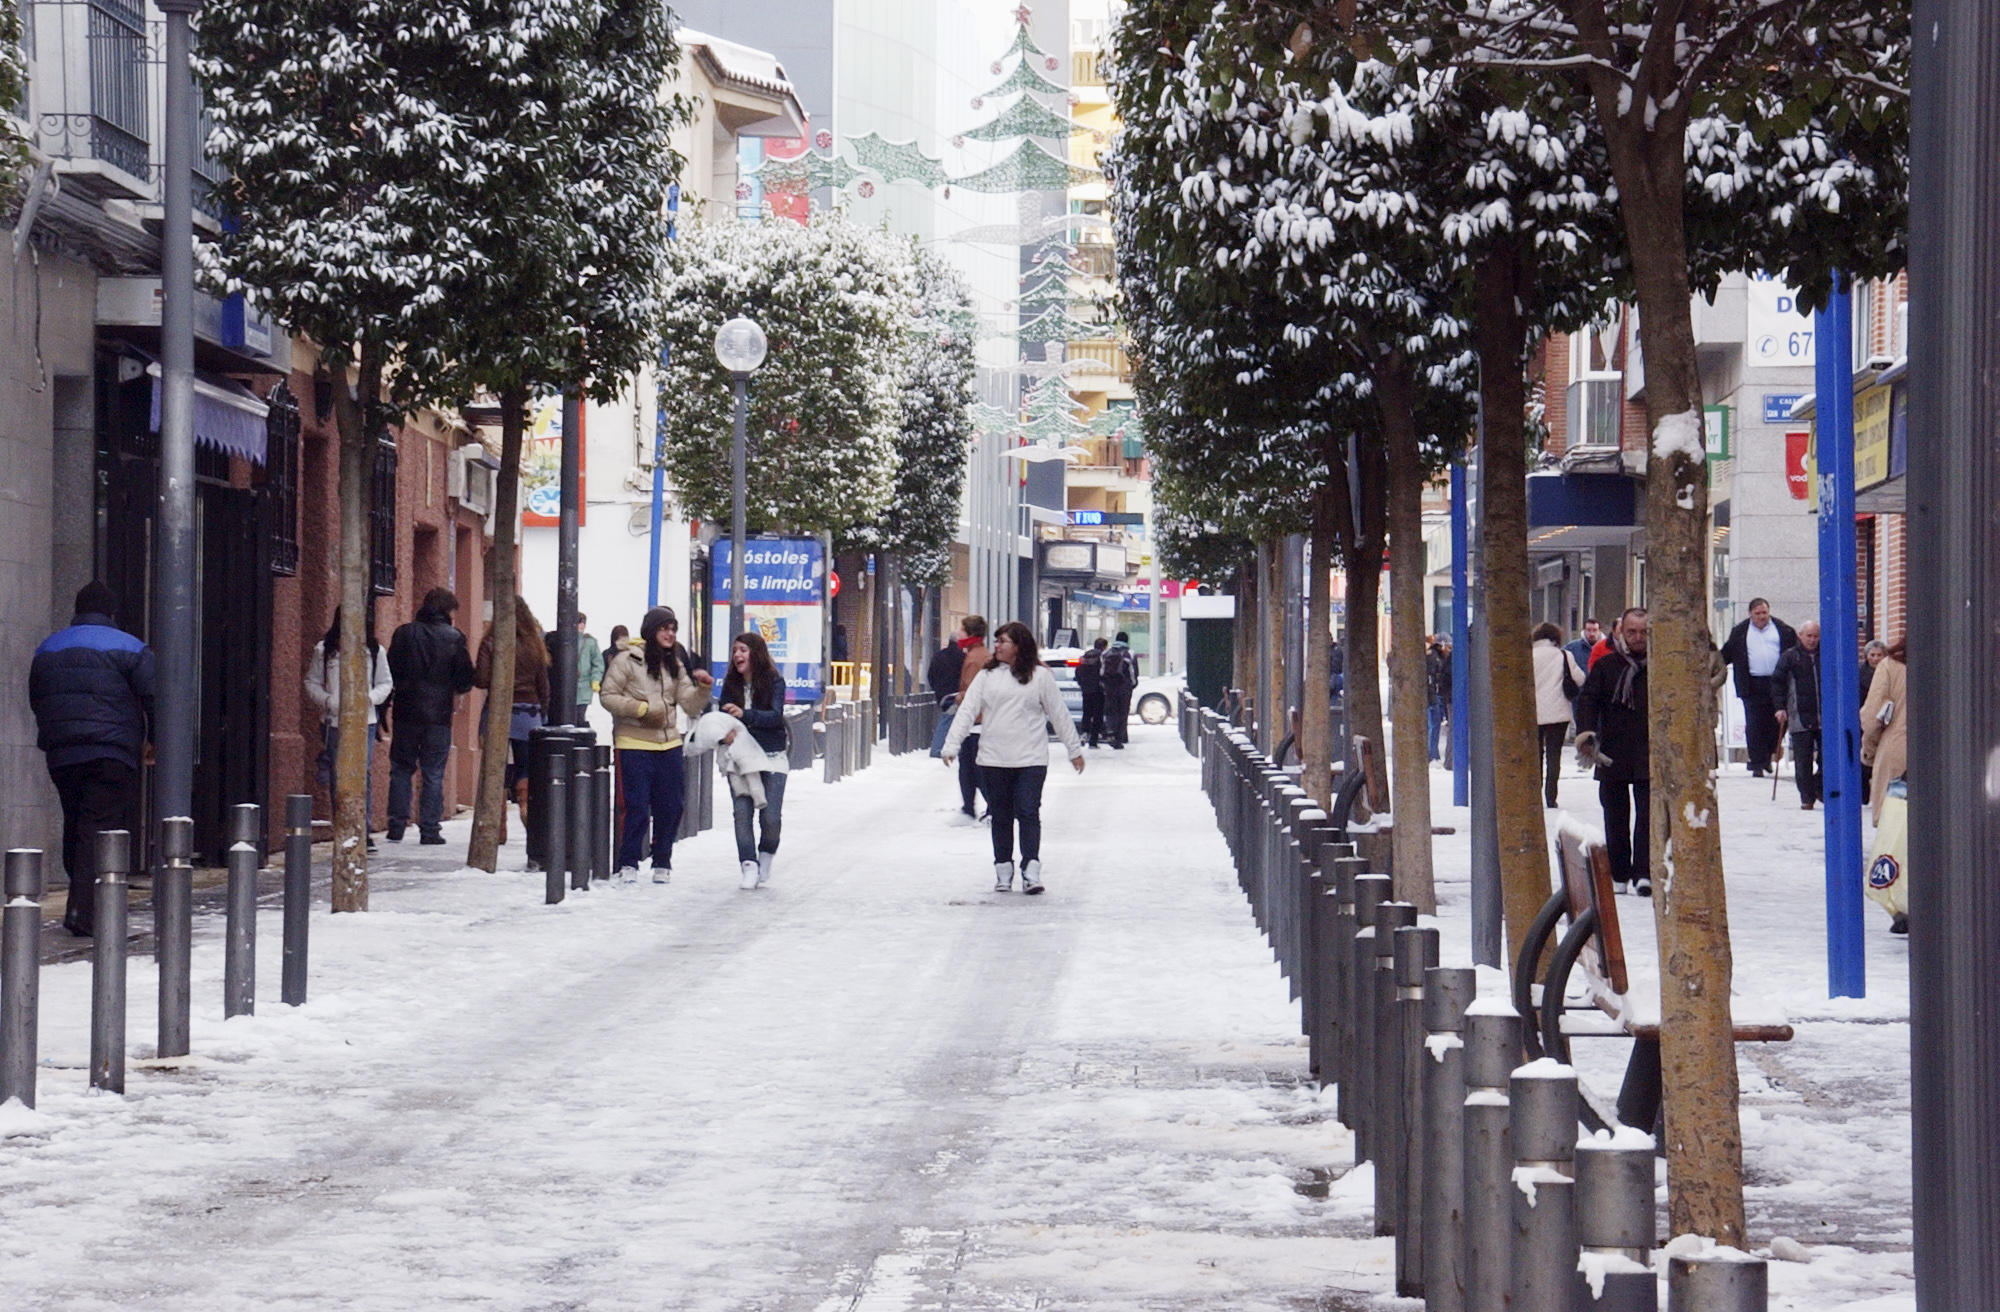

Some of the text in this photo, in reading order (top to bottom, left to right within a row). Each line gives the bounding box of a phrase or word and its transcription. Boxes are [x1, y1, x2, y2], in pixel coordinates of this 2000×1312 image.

[1788, 331, 1813, 357] 67
[726, 549, 809, 565] óstoles
[761, 575, 814, 593] limpio
[784, 677, 816, 688] odos
